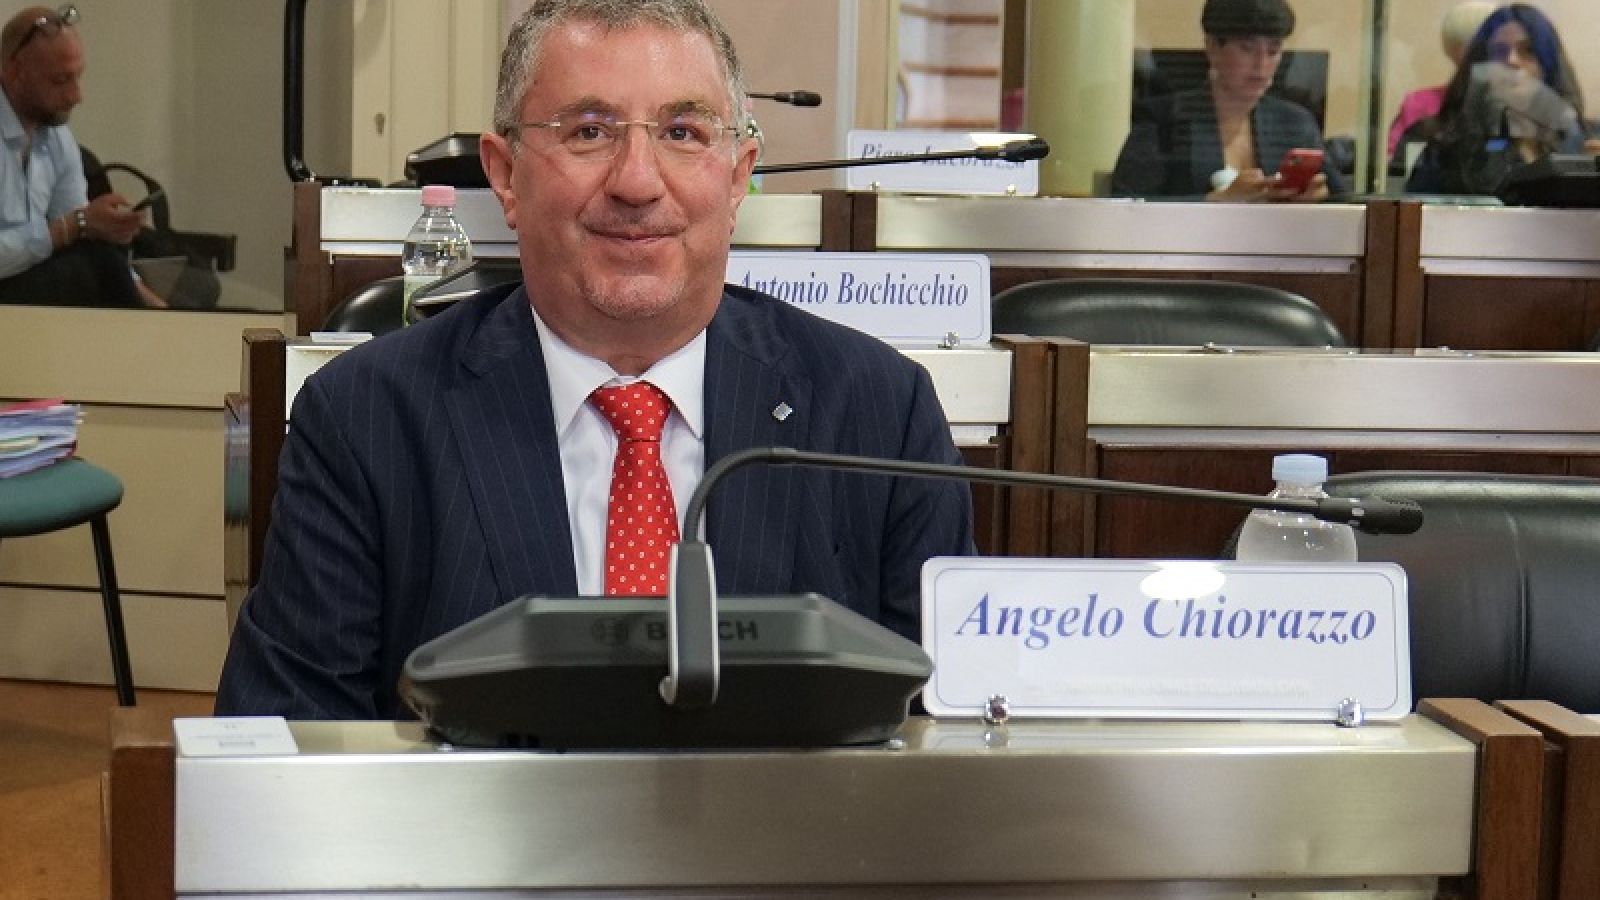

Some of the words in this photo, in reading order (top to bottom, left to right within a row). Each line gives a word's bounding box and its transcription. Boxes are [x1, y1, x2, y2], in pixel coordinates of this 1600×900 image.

[836, 272, 968, 306] Bochicchio
[647, 620, 758, 641] BCH
[954, 592, 1124, 648] Angelo
[1144, 596, 1376, 644] Chiorazzo
